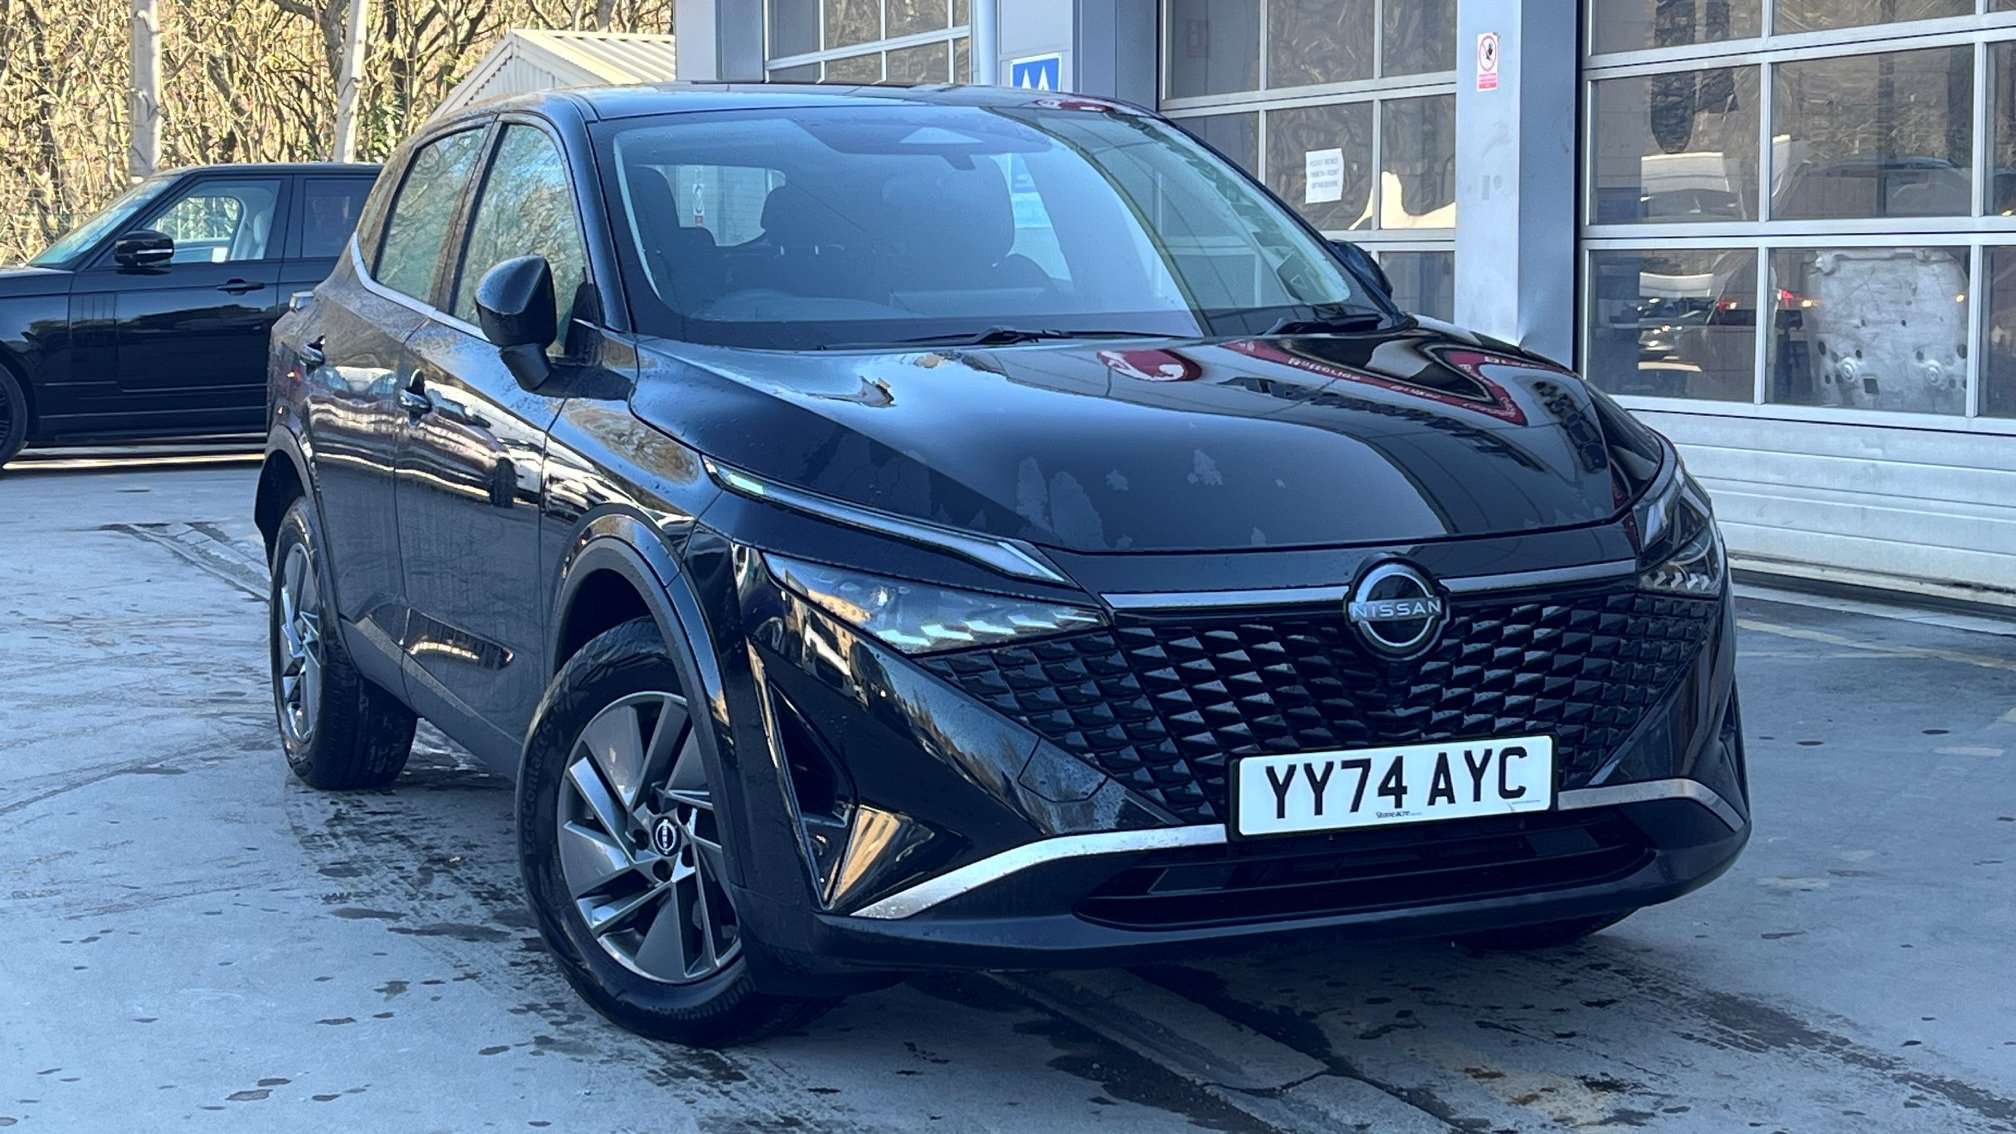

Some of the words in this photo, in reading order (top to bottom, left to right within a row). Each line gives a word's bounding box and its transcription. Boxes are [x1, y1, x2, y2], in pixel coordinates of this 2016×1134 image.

[1351, 599, 1441, 618] NISSAN
[1265, 755, 1408, 820] YY74
[1427, 746, 1528, 806] AYC
